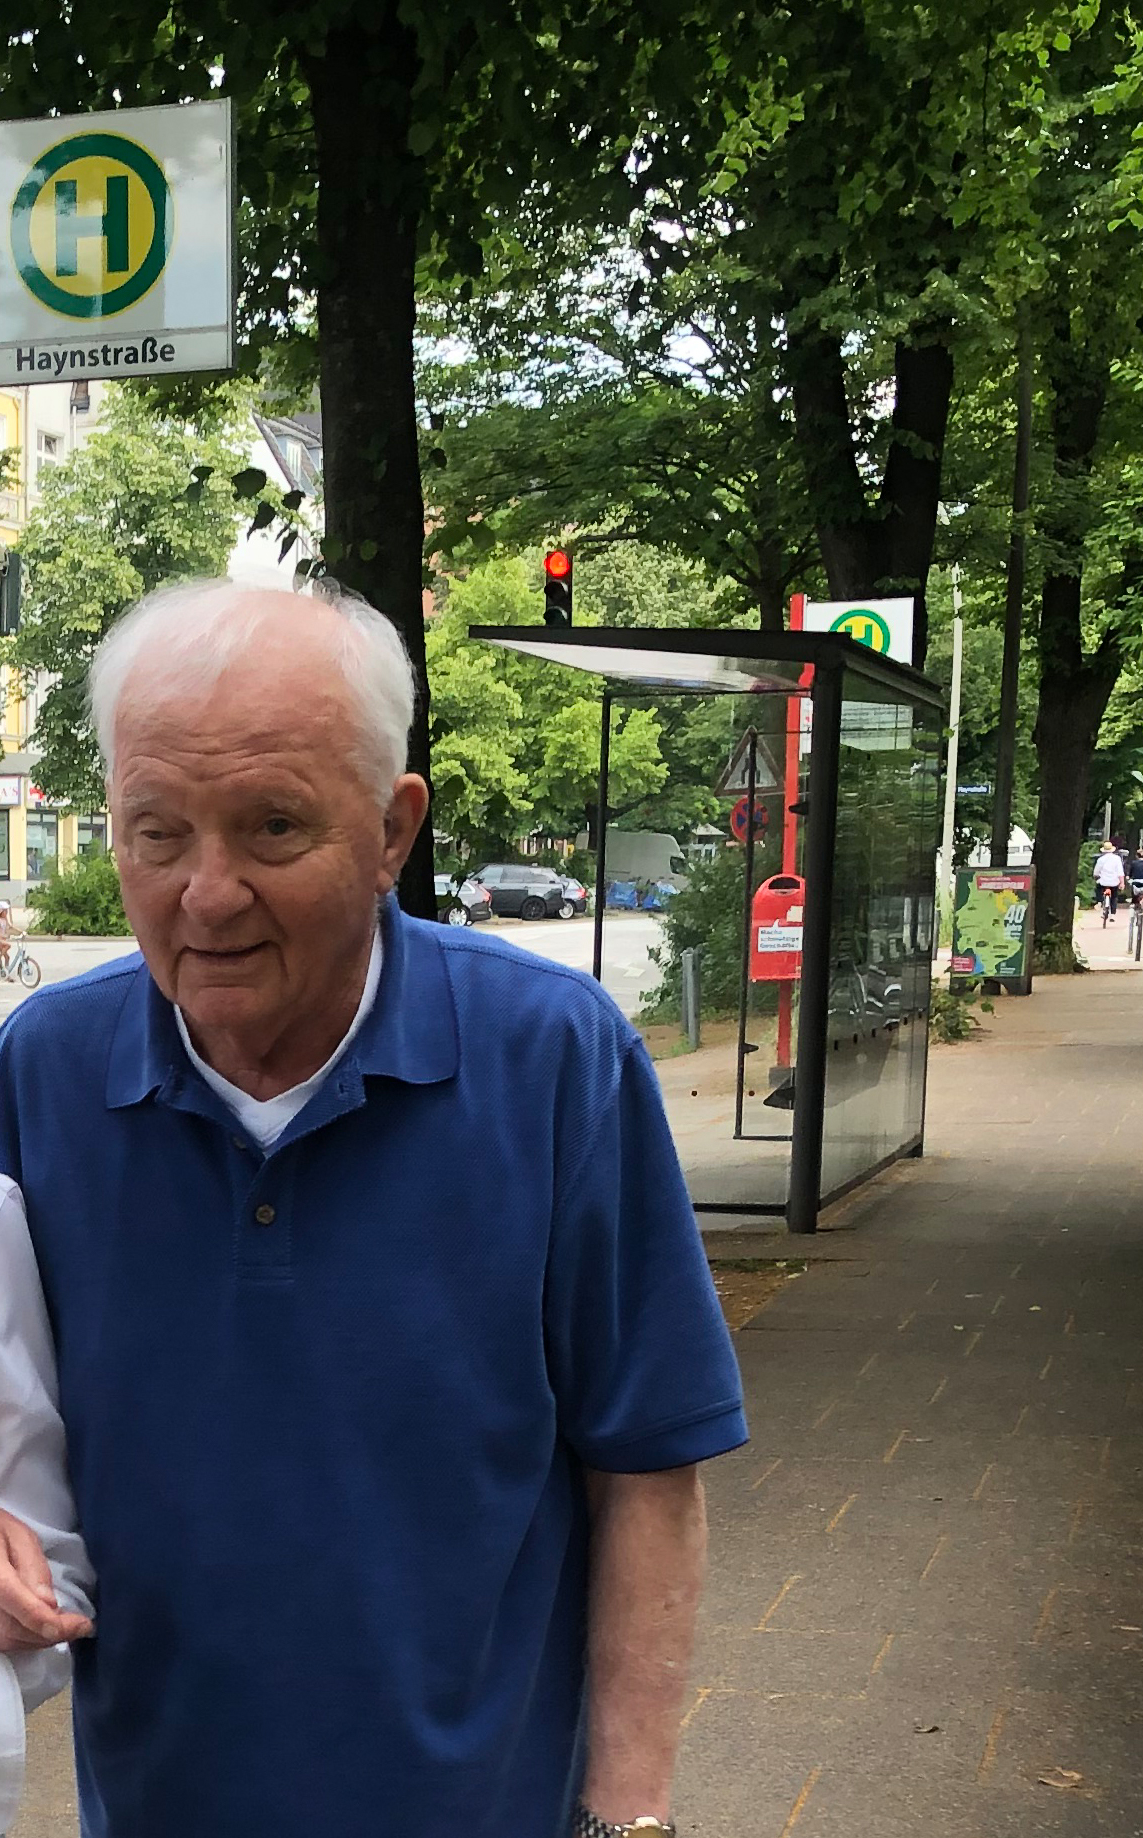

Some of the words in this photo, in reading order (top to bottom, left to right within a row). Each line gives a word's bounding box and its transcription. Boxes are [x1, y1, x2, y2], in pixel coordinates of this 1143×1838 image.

[55, 175, 129, 277] H
[16, 337, 176, 376] Haynstraße
[1003, 904, 1026, 924] 40
